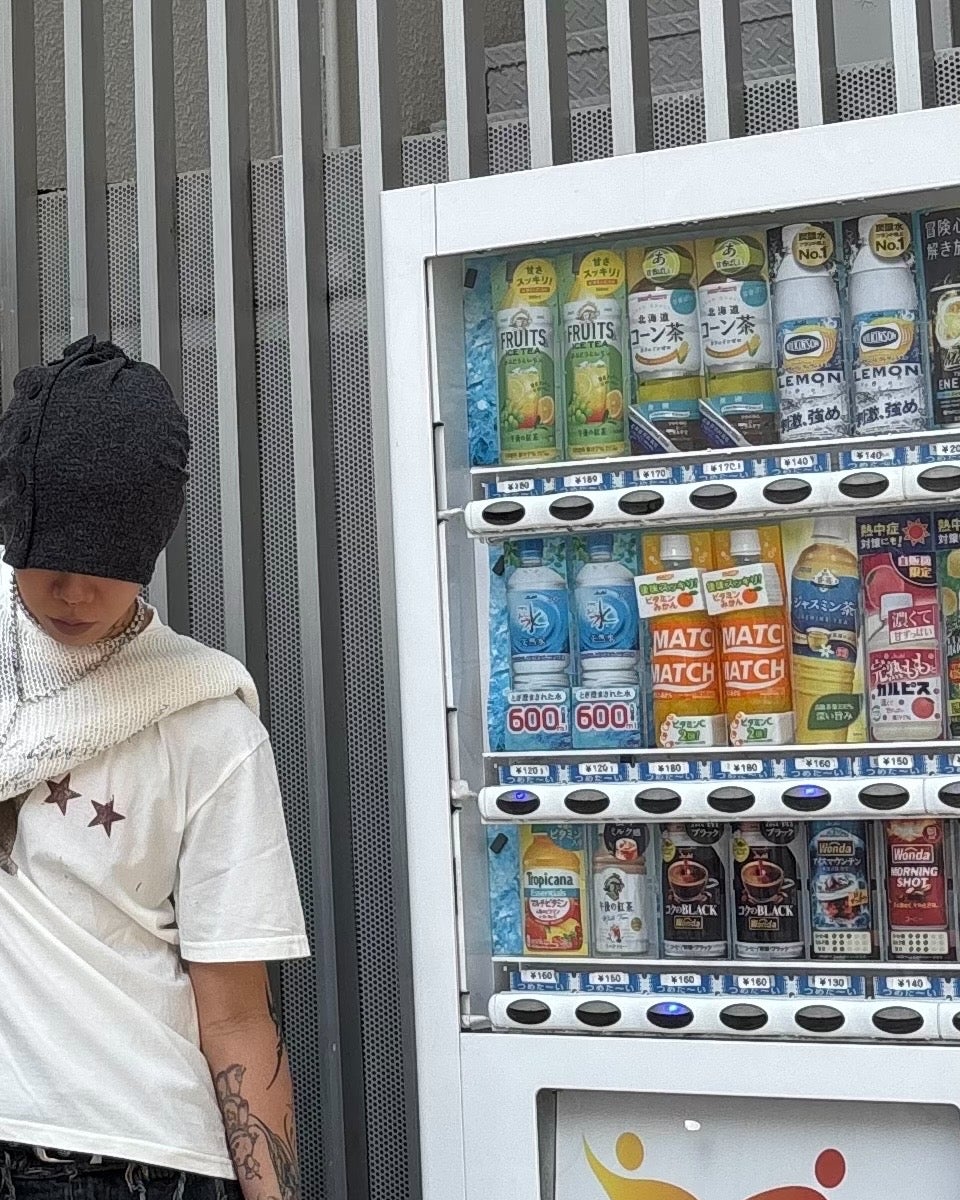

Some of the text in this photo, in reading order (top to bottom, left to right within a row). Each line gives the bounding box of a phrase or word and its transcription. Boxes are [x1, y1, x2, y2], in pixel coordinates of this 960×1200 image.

[875, 237, 905, 252] No.1
[799, 245, 828, 260] No.1
[591, 257, 610, 267] 甘さ
[707, 305, 740, 317] 北海道
[638, 312, 670, 325] 北海道
[567, 321, 615, 344] FRUITS
[700, 314, 756, 339] コーン茶
[500, 328, 547, 350] FRUITS
[630, 322, 685, 346] コーン茶
[853, 365, 919, 381] LEMON
[778, 372, 841, 389] LEMON
[784, 457, 808, 467] ¥140
[856, 451, 881, 460] ¥140
[642, 469, 666, 478] ¥170
[793, 596, 856, 617] ジャスミン茶
[877, 681, 931, 696] カルピス
[819, 842, 852, 854] Wonda
[893, 847, 931, 861] Wonda
[891, 866, 939, 877] MORNING
[527, 871, 574, 888] Tropicana
[896, 877, 929, 888] SHOT
[819, 978, 845, 987] ¥130
[897, 978, 923, 988] ¥140
